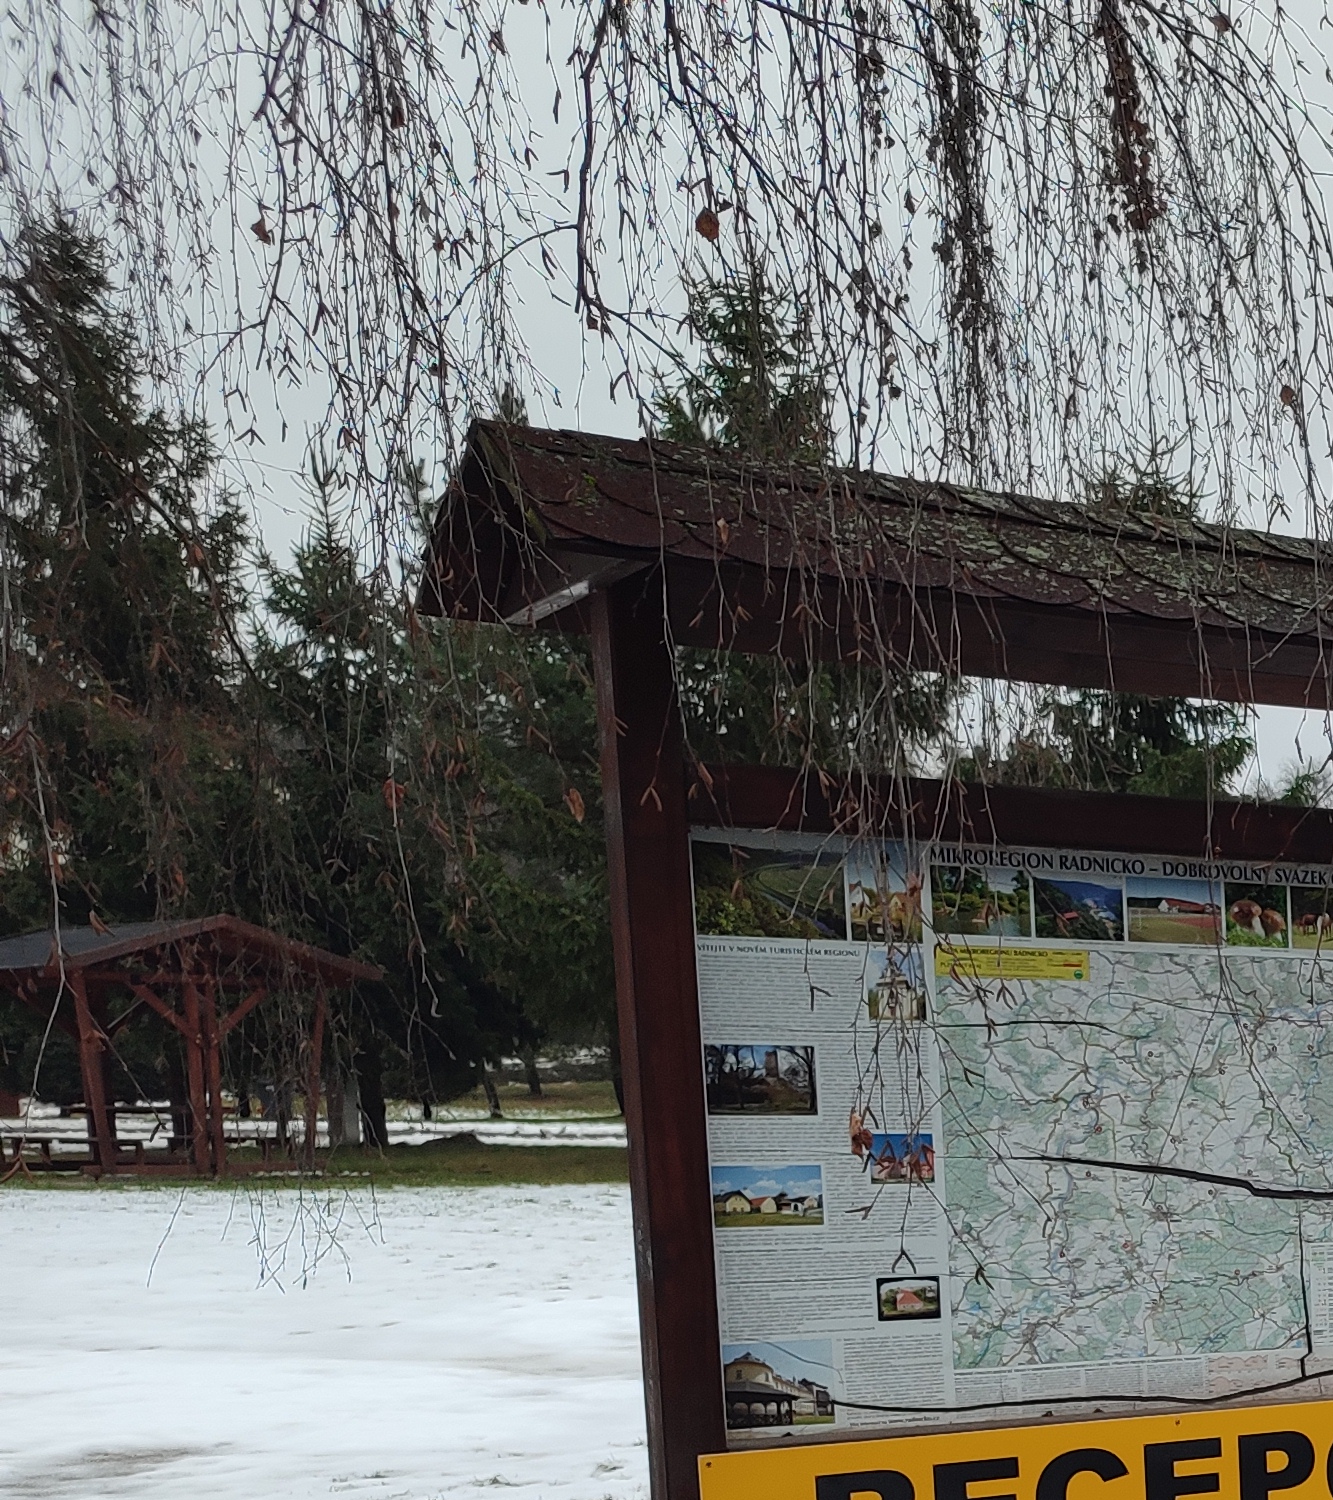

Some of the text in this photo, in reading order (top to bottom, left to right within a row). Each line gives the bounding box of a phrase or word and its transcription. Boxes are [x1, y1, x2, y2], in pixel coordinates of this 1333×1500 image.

[930, 847, 1054, 870] MIKROREGION
[1059, 854, 1145, 875] RADNICKO
[1275, 870, 1328, 886] SVAZEK
